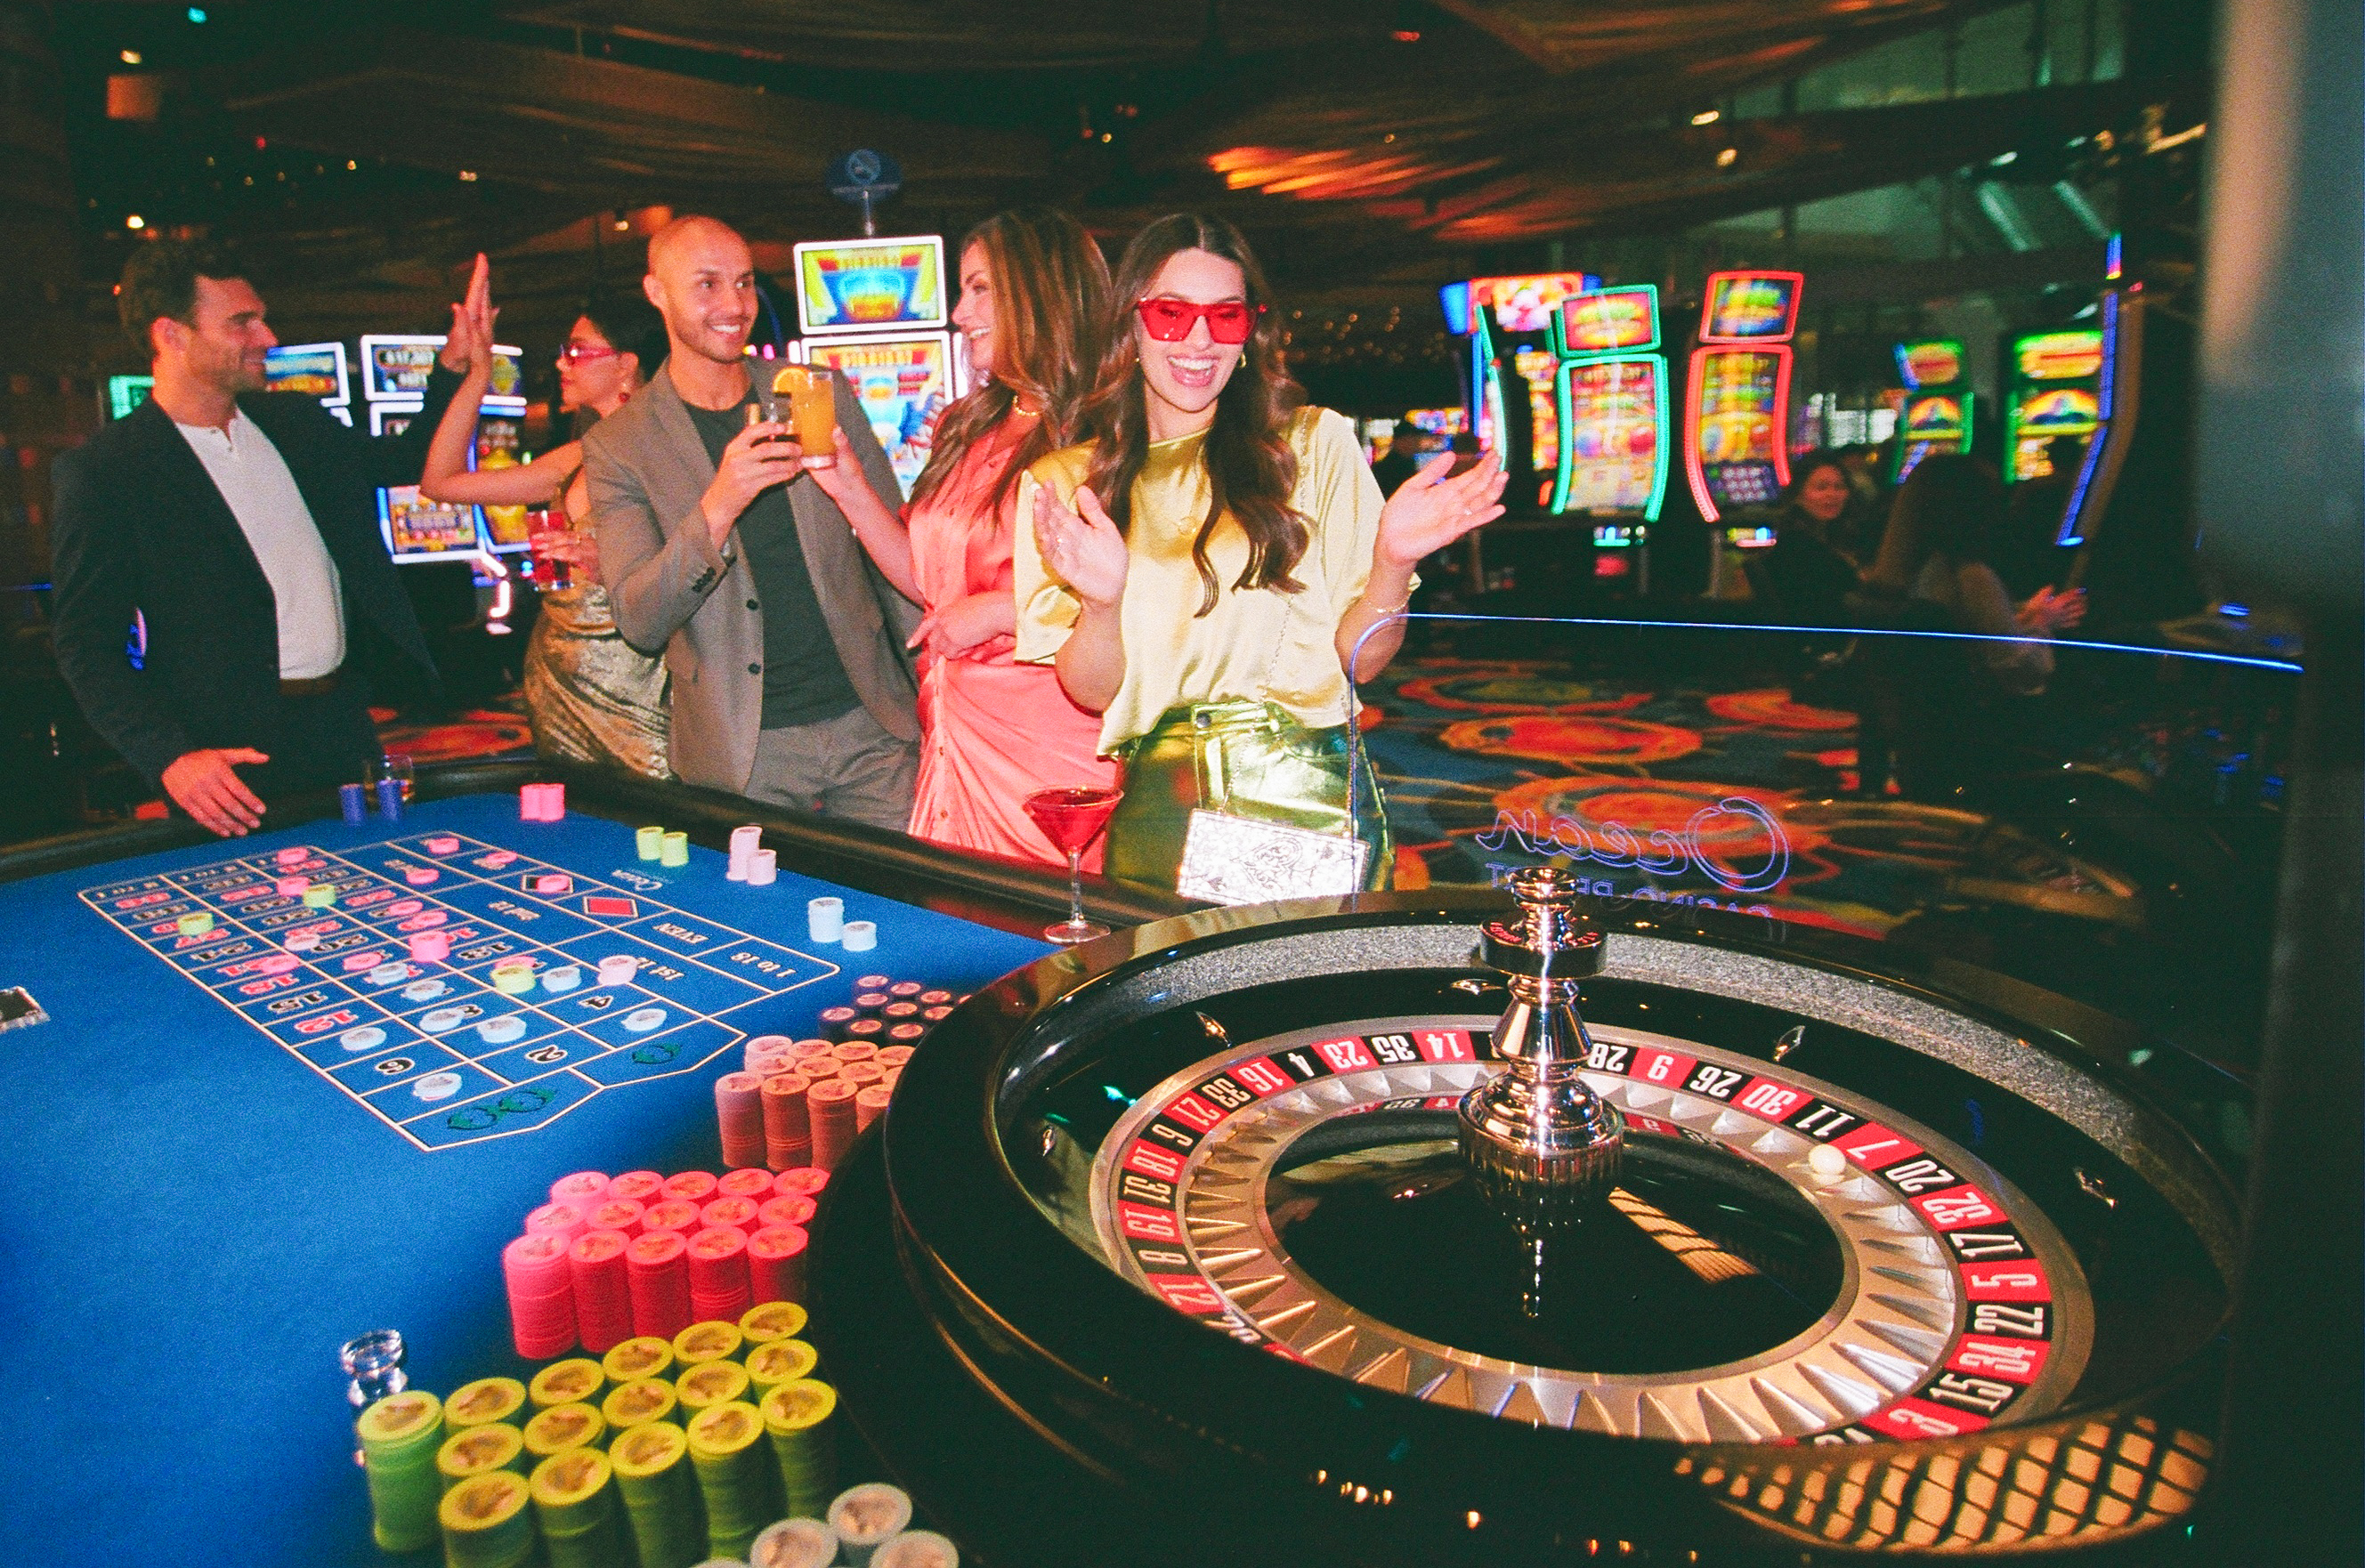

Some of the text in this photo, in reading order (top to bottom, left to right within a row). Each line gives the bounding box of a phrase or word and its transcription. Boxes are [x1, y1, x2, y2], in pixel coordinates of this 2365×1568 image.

[652, 923, 709, 944] EVEN
[266, 990, 328, 1014] 15
[579, 994, 616, 1011] 4
[293, 1007, 358, 1035] 12
[524, 1044, 569, 1064] 2
[1323, 1041, 1369, 1068] 23
[1372, 1036, 1416, 1063] 35
[1426, 1032, 1466, 1059] 14
[1588, 1043, 1626, 1072] 28
[1241, 1062, 1287, 1093] 16
[1288, 1052, 1316, 1078] 4
[1201, 1077, 1251, 1109] 33
[1696, 1065, 1743, 1099] 26
[1741, 1082, 1802, 1118] 30
[1171, 1101, 1221, 1130] 21
[1794, 1102, 1857, 1137] 11
[1134, 1145, 1178, 1179] 18
[1847, 1138, 1900, 1160] 7
[1122, 1175, 1172, 1205] 31
[1885, 1159, 1956, 1193] 20
[1922, 1191, 1992, 1224] 32
[1123, 1208, 1176, 1240] 19
[1138, 1249, 1188, 1265] 8
[1950, 1231, 2024, 1259] 17
[1157, 1281, 1221, 1305] 12
[1972, 1271, 2038, 1289] 5
[1974, 1303, 2045, 1339] 22
[1959, 1340, 2037, 1375] 34
[1929, 1372, 2015, 1413] 15
[1888, 1408, 1959, 1436] 3
